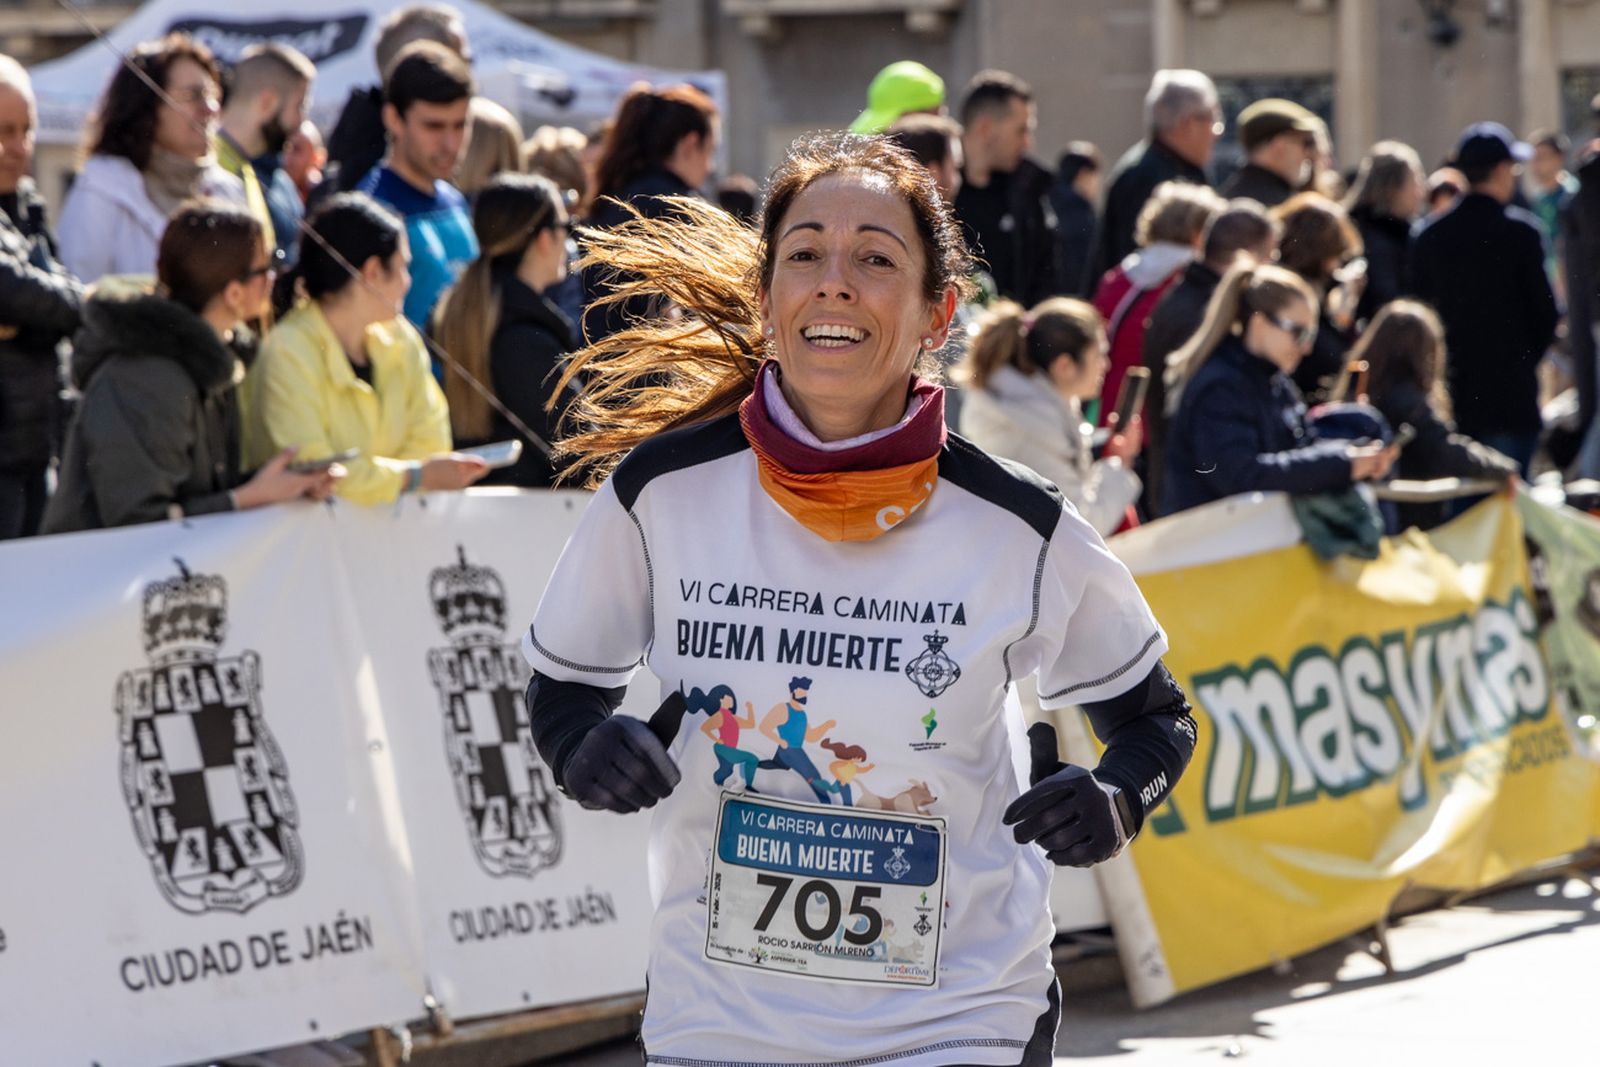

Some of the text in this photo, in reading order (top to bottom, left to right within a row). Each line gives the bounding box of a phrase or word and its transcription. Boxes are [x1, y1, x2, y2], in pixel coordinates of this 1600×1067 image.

[679, 578, 967, 626] VI CARRERA CAMINATA
[677, 619, 903, 673] BUENA MUERTE
[741, 809, 914, 845] VI CARRERA CAMINATA
[736, 834, 875, 875] BUENA MUERTE
[449, 902, 535, 943] CIUDAD
[753, 873, 884, 946] 705
[119, 909, 374, 992] CIUDAD DE JAÉN
[757, 935, 788, 948] ROCIO
[791, 942, 832, 954] SARRIÓN
